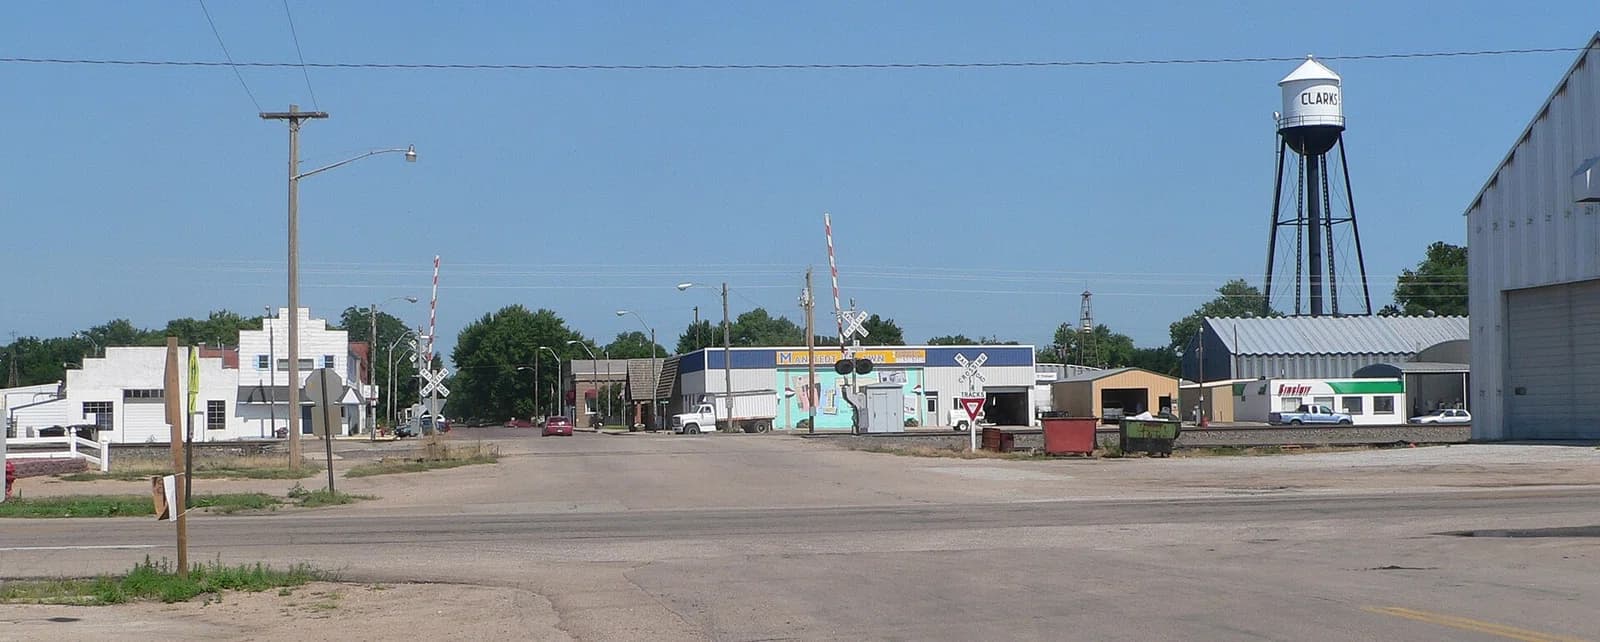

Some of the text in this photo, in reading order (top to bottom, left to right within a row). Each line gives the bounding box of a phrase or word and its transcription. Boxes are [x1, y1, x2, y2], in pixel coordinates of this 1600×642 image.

[1301, 92, 1337, 105] CLARKS
[958, 355, 986, 383] CROSSING
[1278, 384, 1312, 395] Sinclair
